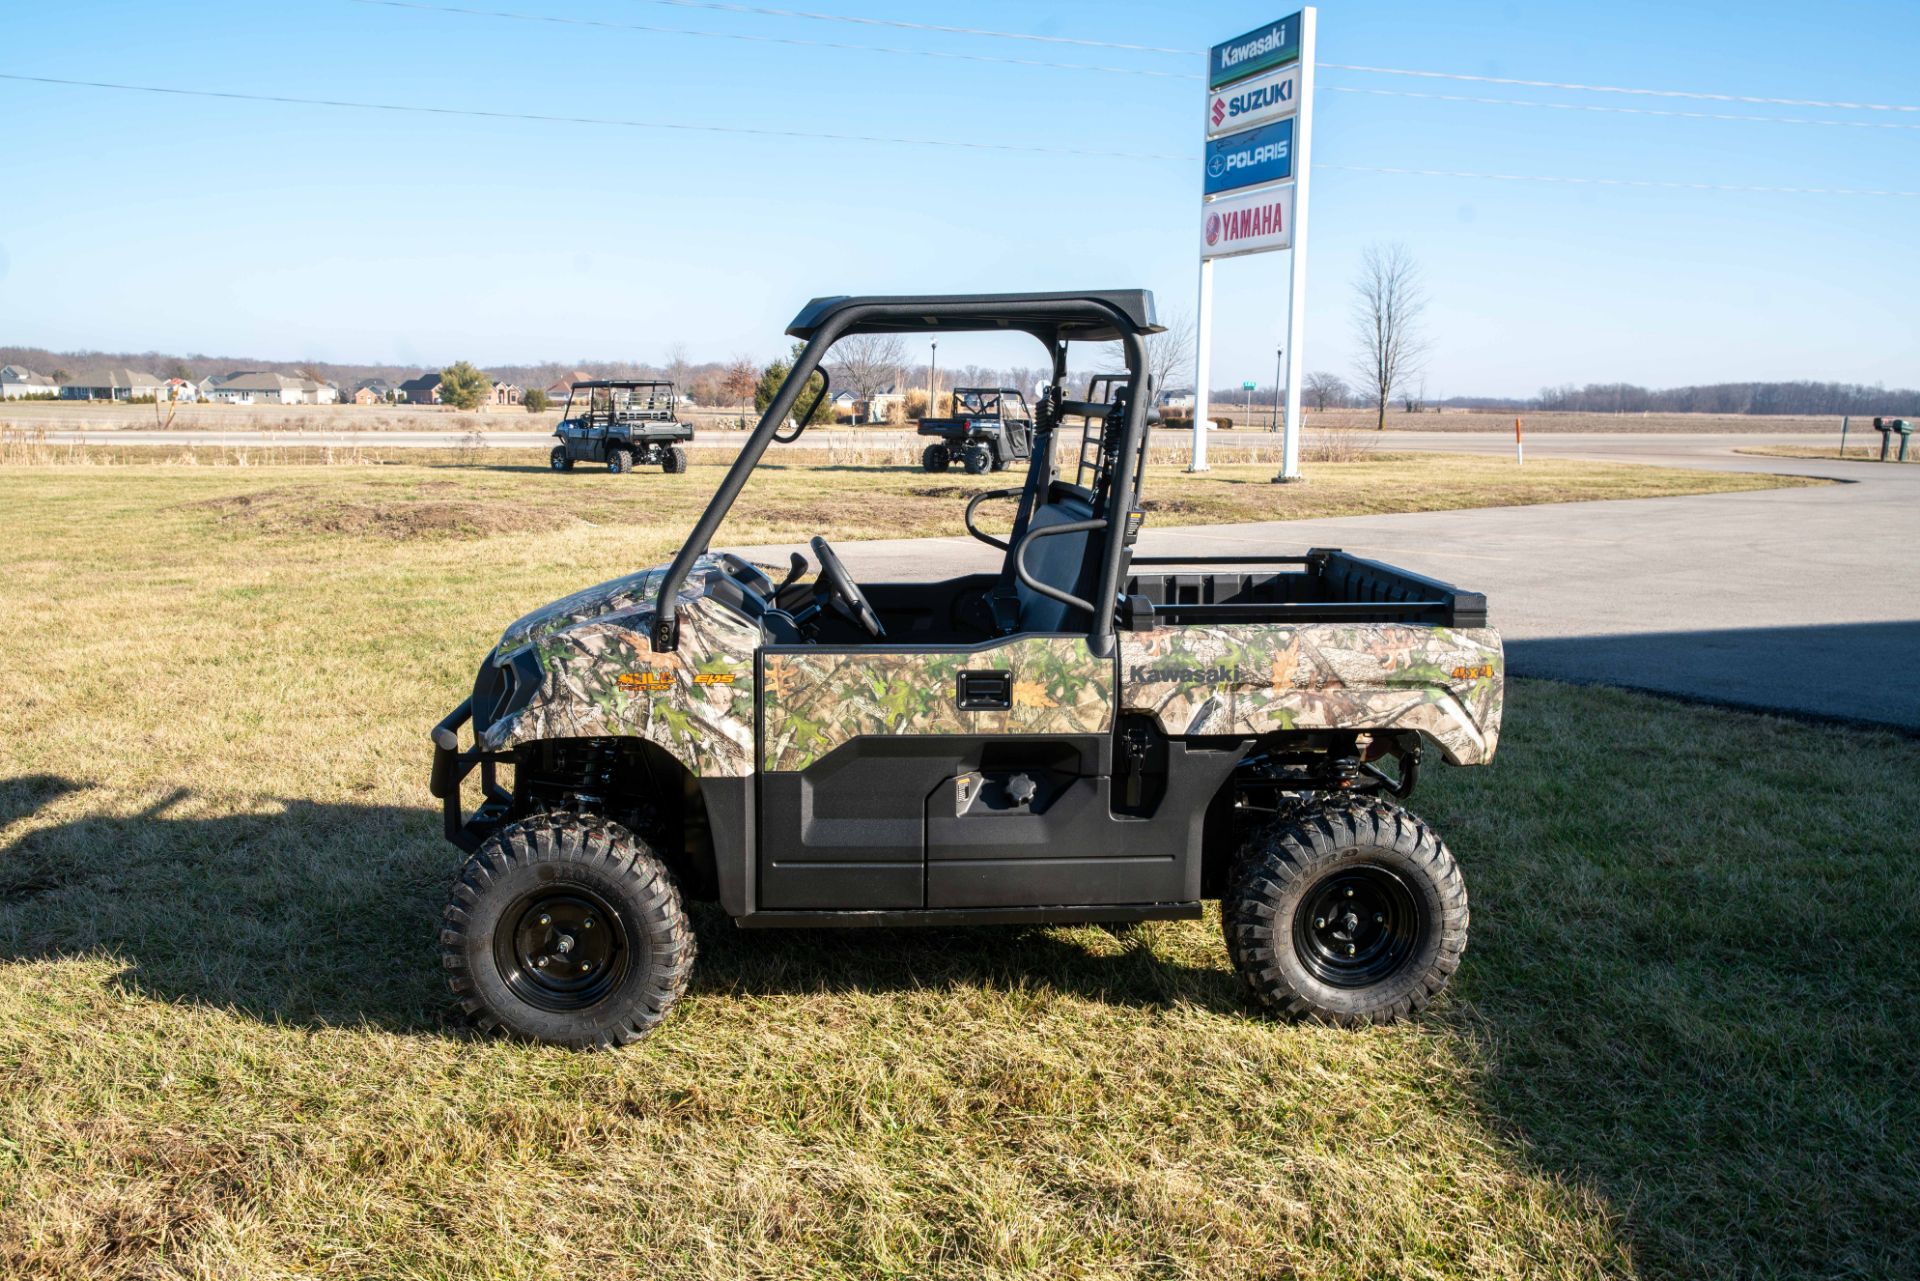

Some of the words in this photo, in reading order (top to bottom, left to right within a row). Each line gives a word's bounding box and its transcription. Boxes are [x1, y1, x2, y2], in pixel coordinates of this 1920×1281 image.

[1221, 25, 1286, 68] Kawasaki
[1229, 79, 1292, 117] SUZUKI
[1226, 141, 1288, 171] POLARIS
[1222, 203, 1282, 241] YAMAHA
[1130, 664, 1241, 682] Kawasaki
